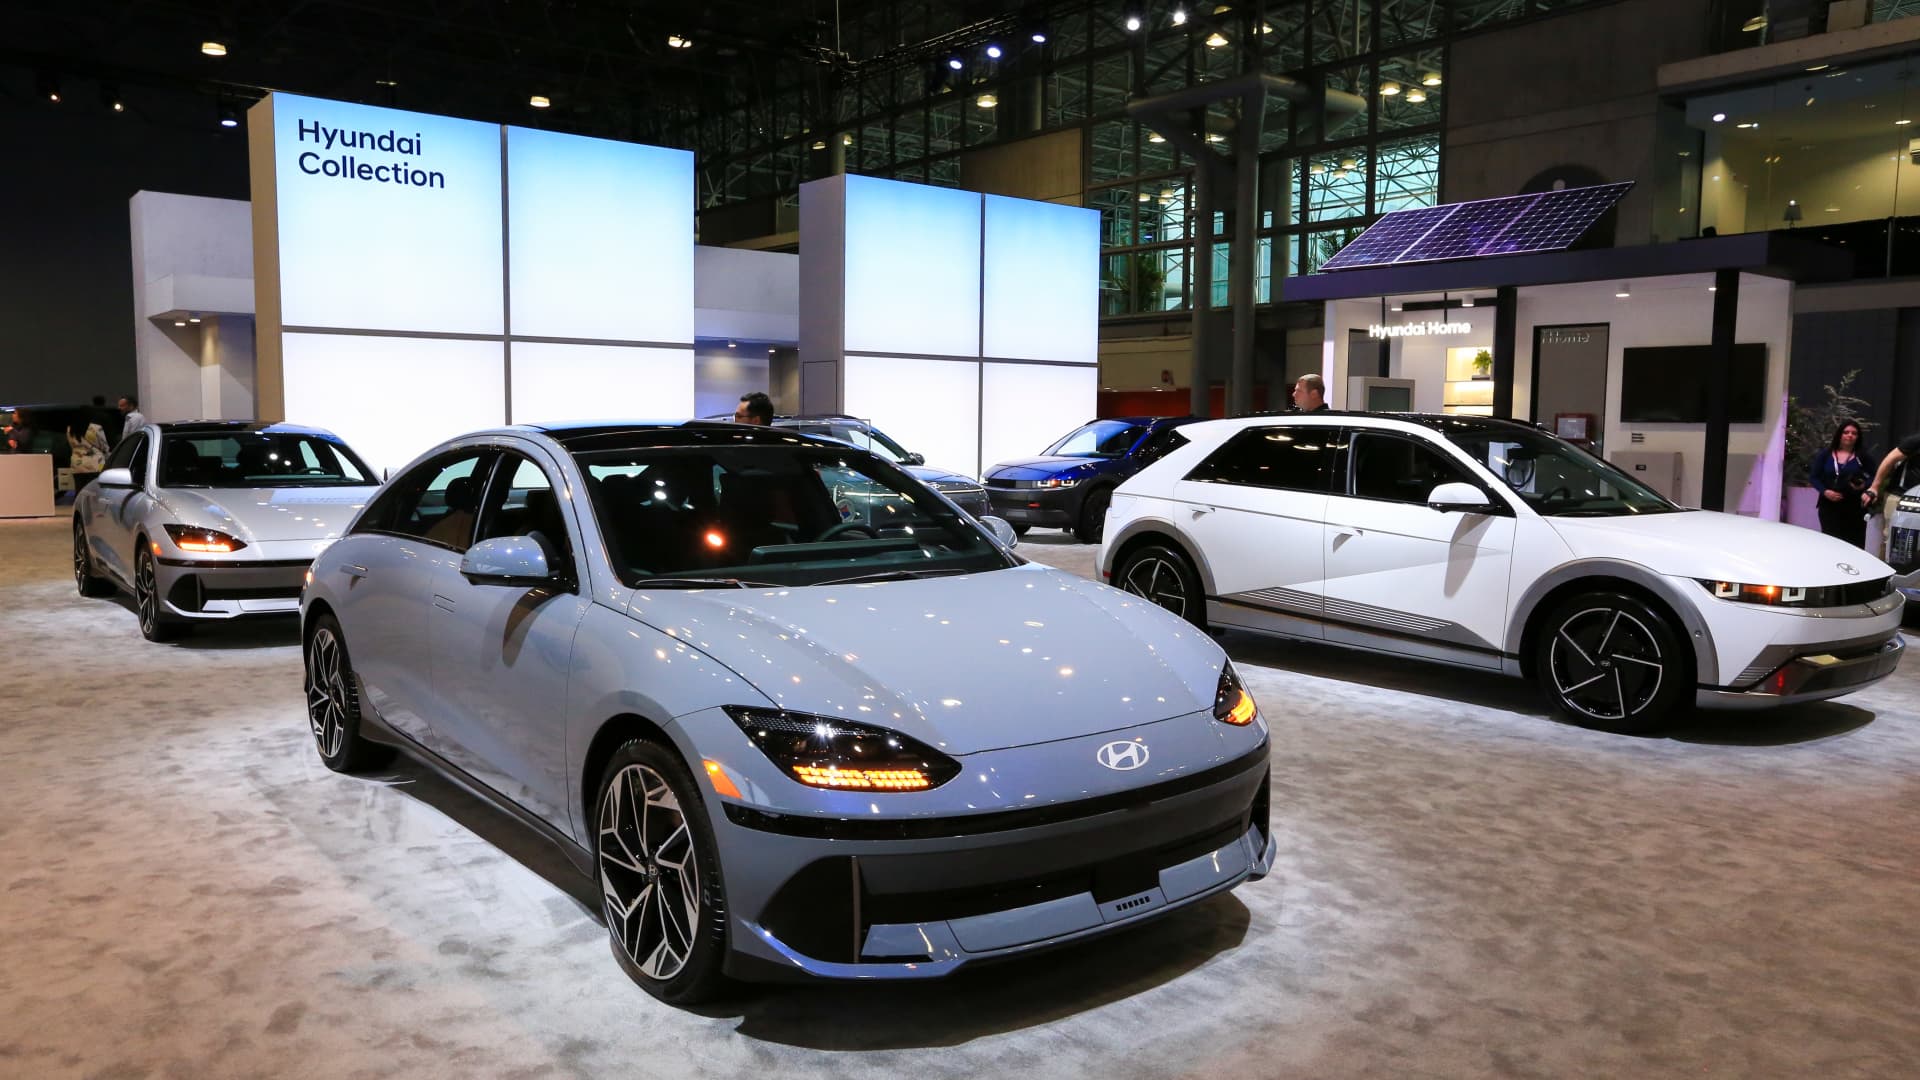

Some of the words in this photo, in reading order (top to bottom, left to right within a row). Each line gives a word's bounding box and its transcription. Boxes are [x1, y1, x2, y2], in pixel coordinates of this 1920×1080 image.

[298, 119, 422, 156] Hyundai
[298, 151, 445, 189] Collection
[1369, 322, 1425, 340] Hyundai
[1428, 321, 1472, 335] Home
